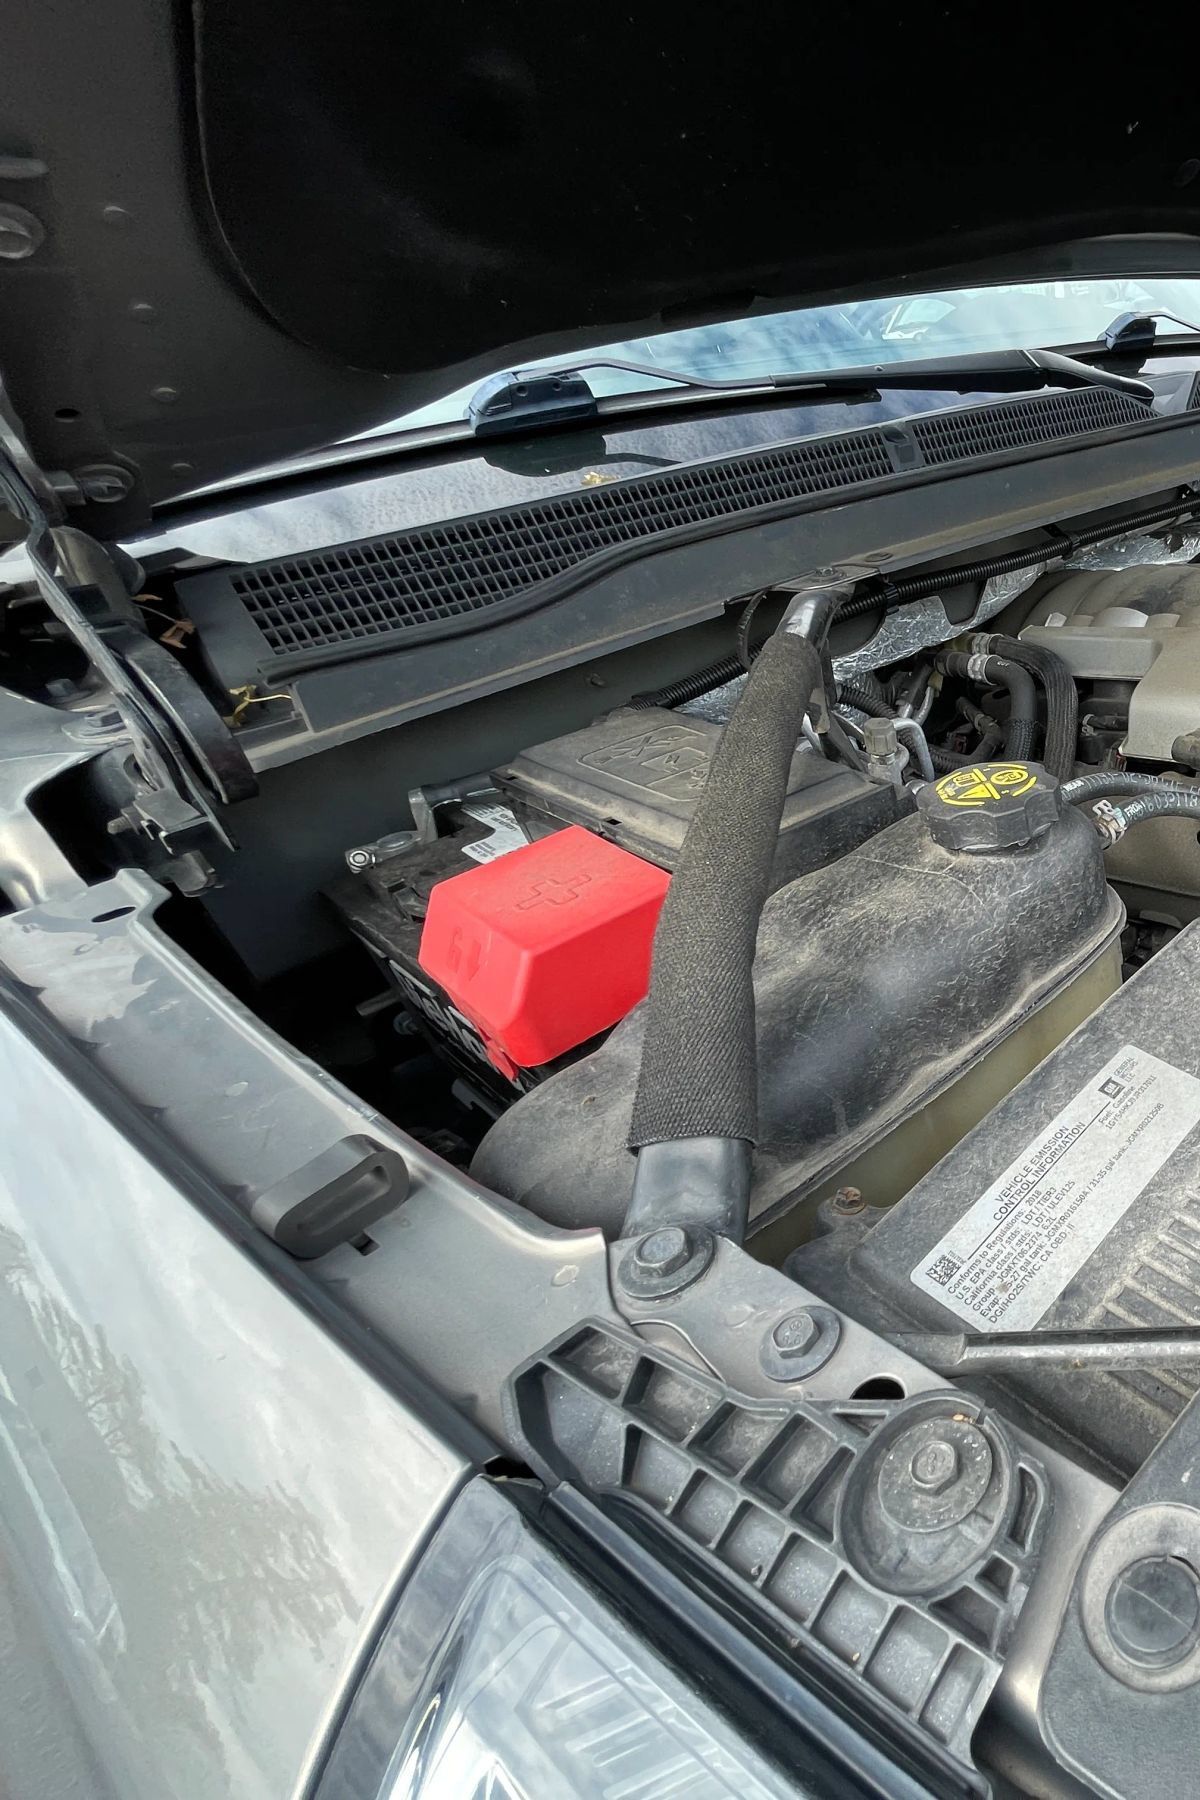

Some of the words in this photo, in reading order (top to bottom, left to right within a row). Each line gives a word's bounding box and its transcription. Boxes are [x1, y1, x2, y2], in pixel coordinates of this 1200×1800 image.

[1111, 1085, 1135, 1108] Gasoline
[991, 1176, 1036, 1221] CONTROL
[1031, 1121, 1086, 1177] INFORMATION
[994, 1164, 1034, 1203] VEHICLE
[1028, 1125, 1070, 1166] EMISSION
[946, 1257, 982, 1294] Conforms
[978, 1249, 989, 1258] to
[984, 1207, 1028, 1251] Regulations:
[1024, 1189, 1042, 1206] 2018
[955, 1283, 973, 1300] U.S.
[968, 1267, 986, 1284] EPA
[982, 1247, 1004, 1268] class
[1003, 1225, 1023, 1245] stds:
[1020, 1209, 1037, 1225] LDT
[1036, 1186, 1057, 1207] TIER3
[963, 1269, 998, 1306] California
[993, 1250, 1014, 1270] class
[1013, 1228, 1033, 1247] stds:
[1031, 1212, 1048, 1227] LDT
[1046, 1179, 1076, 1209] ULEV125
[978, 1293, 1003, 1318] Evap:
[1017, 1257, 1033, 1273] gal
[1026, 1239, 1047, 1260] tank:
[1088, 1168, 1108, 1187] 31-35
[1102, 1159, 1117, 1171] gal
[1039, 1248, 1053, 1262] CA
[1040, 1214, 1057, 1230] 6.2L
